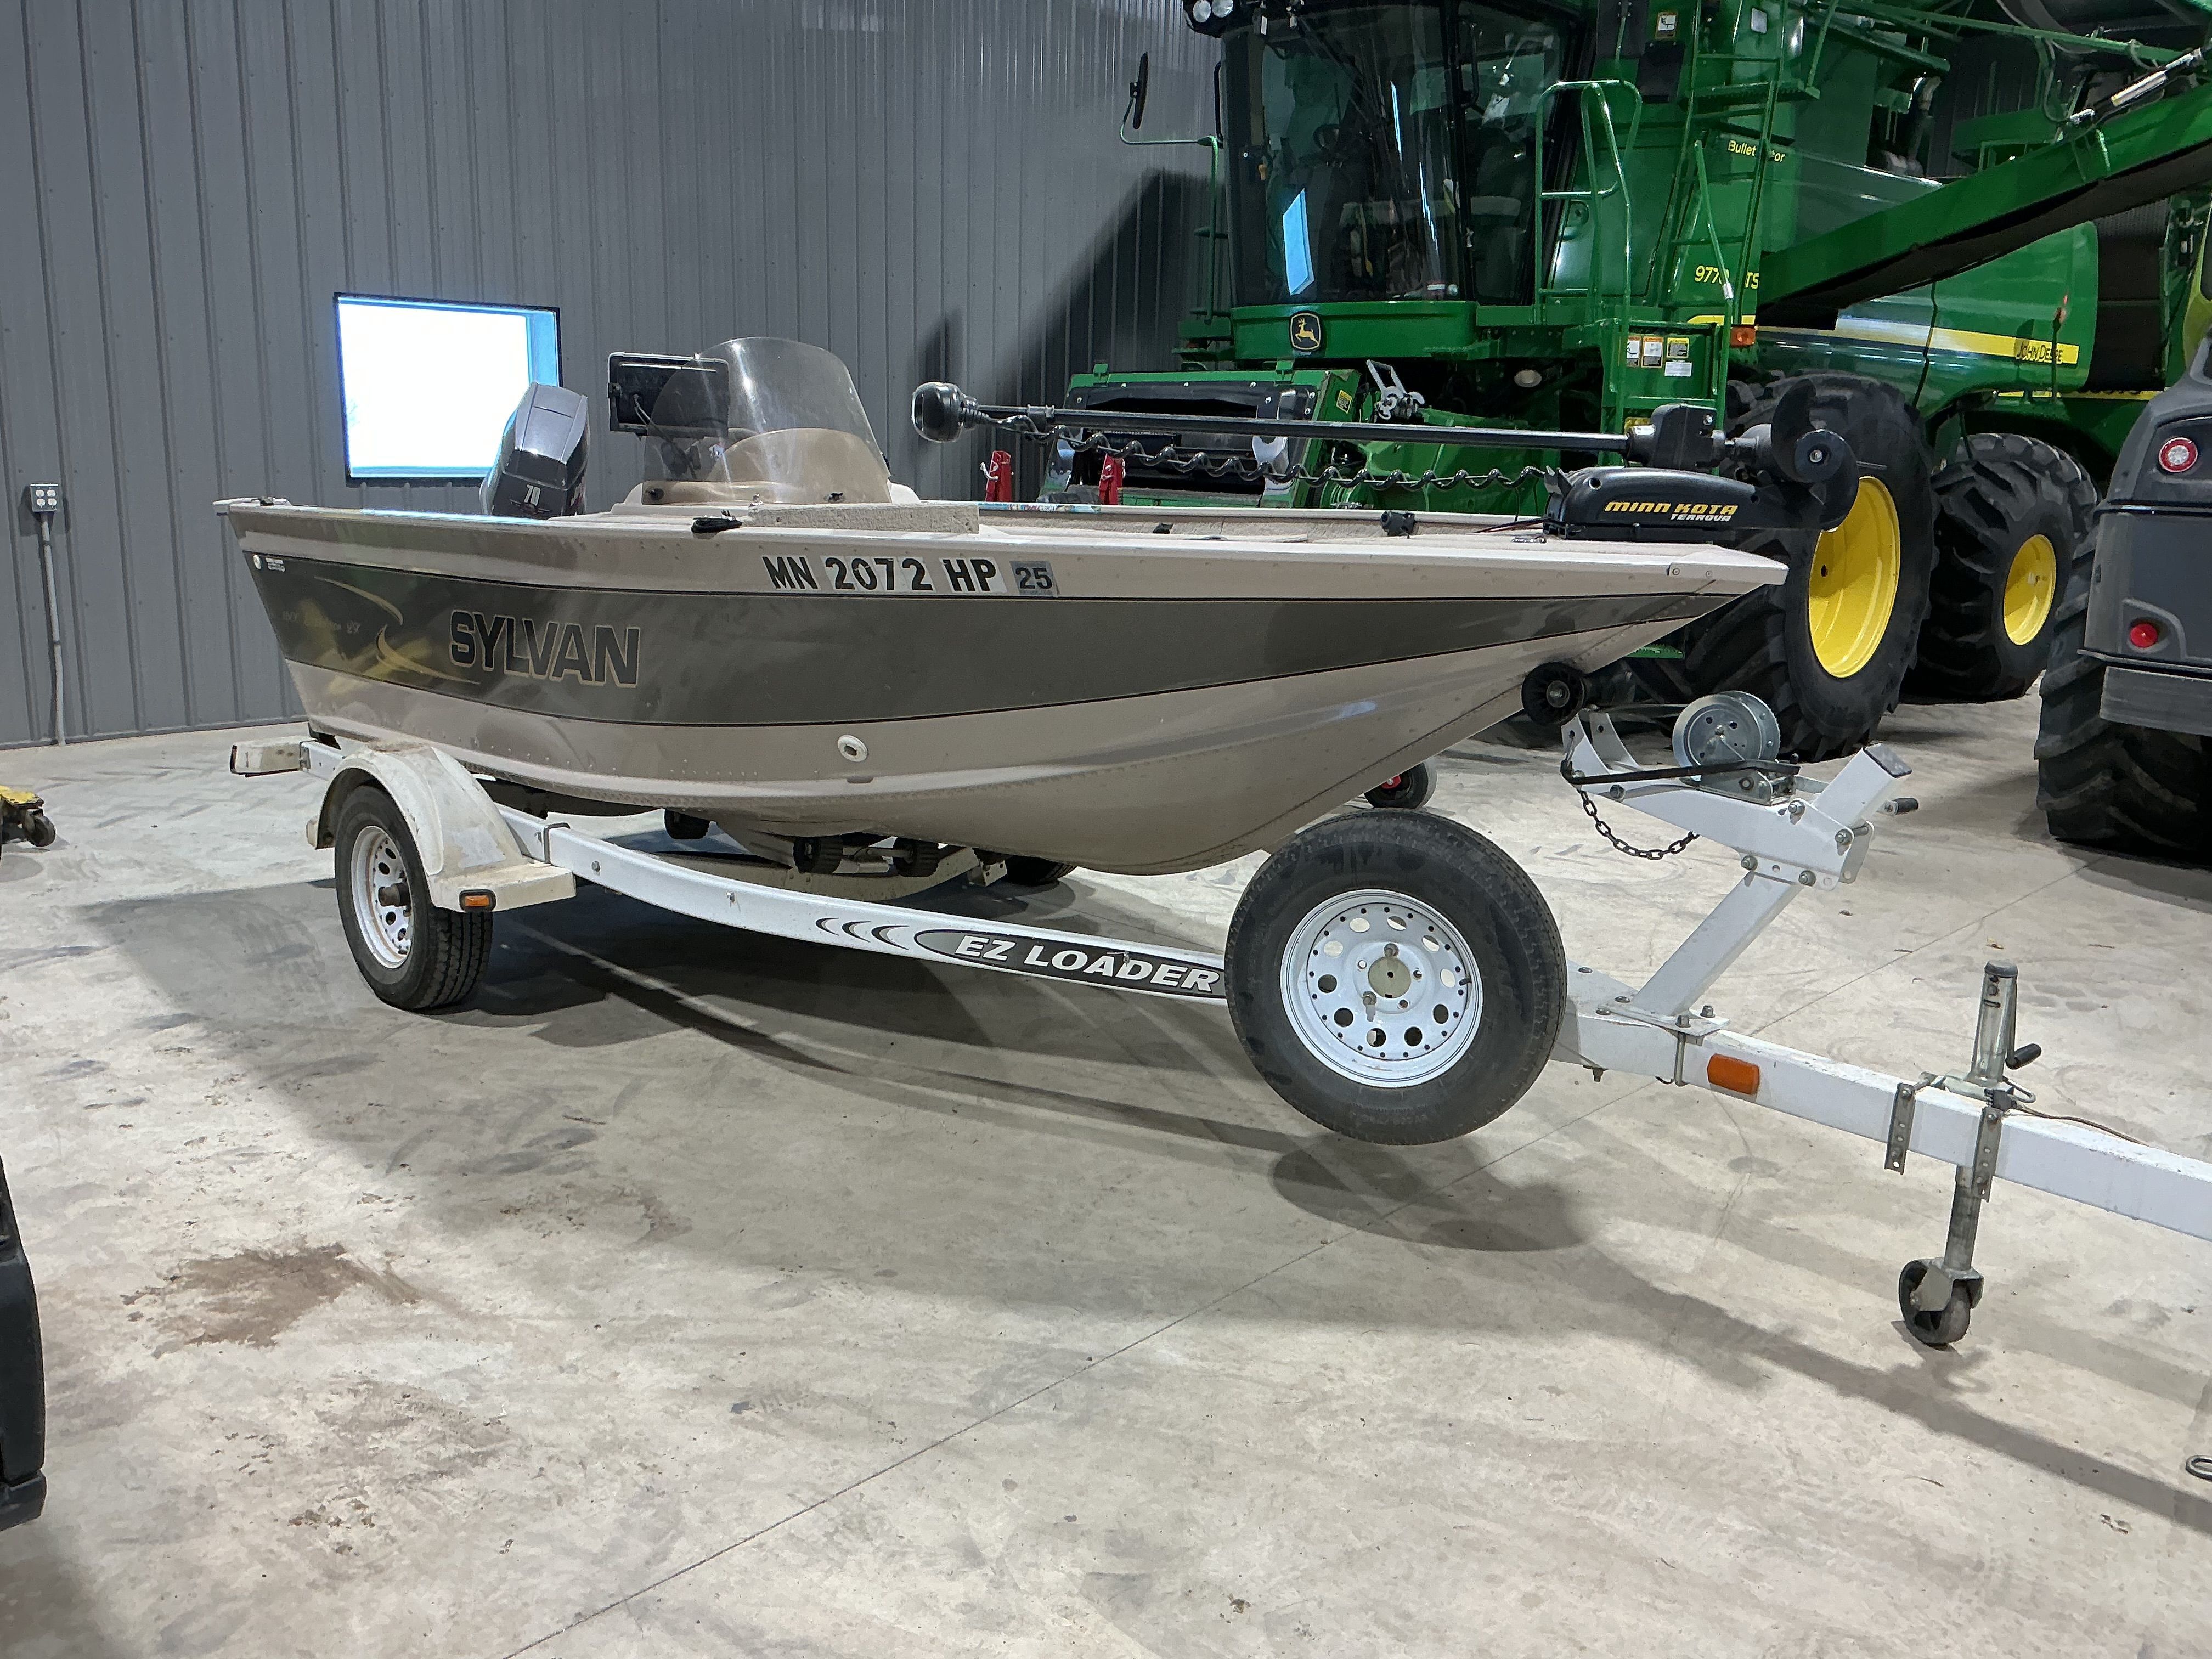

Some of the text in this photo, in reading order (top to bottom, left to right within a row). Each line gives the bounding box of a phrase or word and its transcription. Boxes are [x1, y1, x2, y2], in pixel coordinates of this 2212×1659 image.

[1728, 140, 1757, 157] Bullet
[1745, 272, 1760, 289] TS
[524, 484, 541, 506] 70
[1604, 501, 1739, 515] MINN KOTA
[1670, 514, 1732, 522] TERROVA
[762, 556, 997, 592] MN 2072 HP
[1015, 567, 1053, 589] 25
[449, 610, 641, 689] SYLVAN
[954, 935, 1221, 992] EZ LOADER
